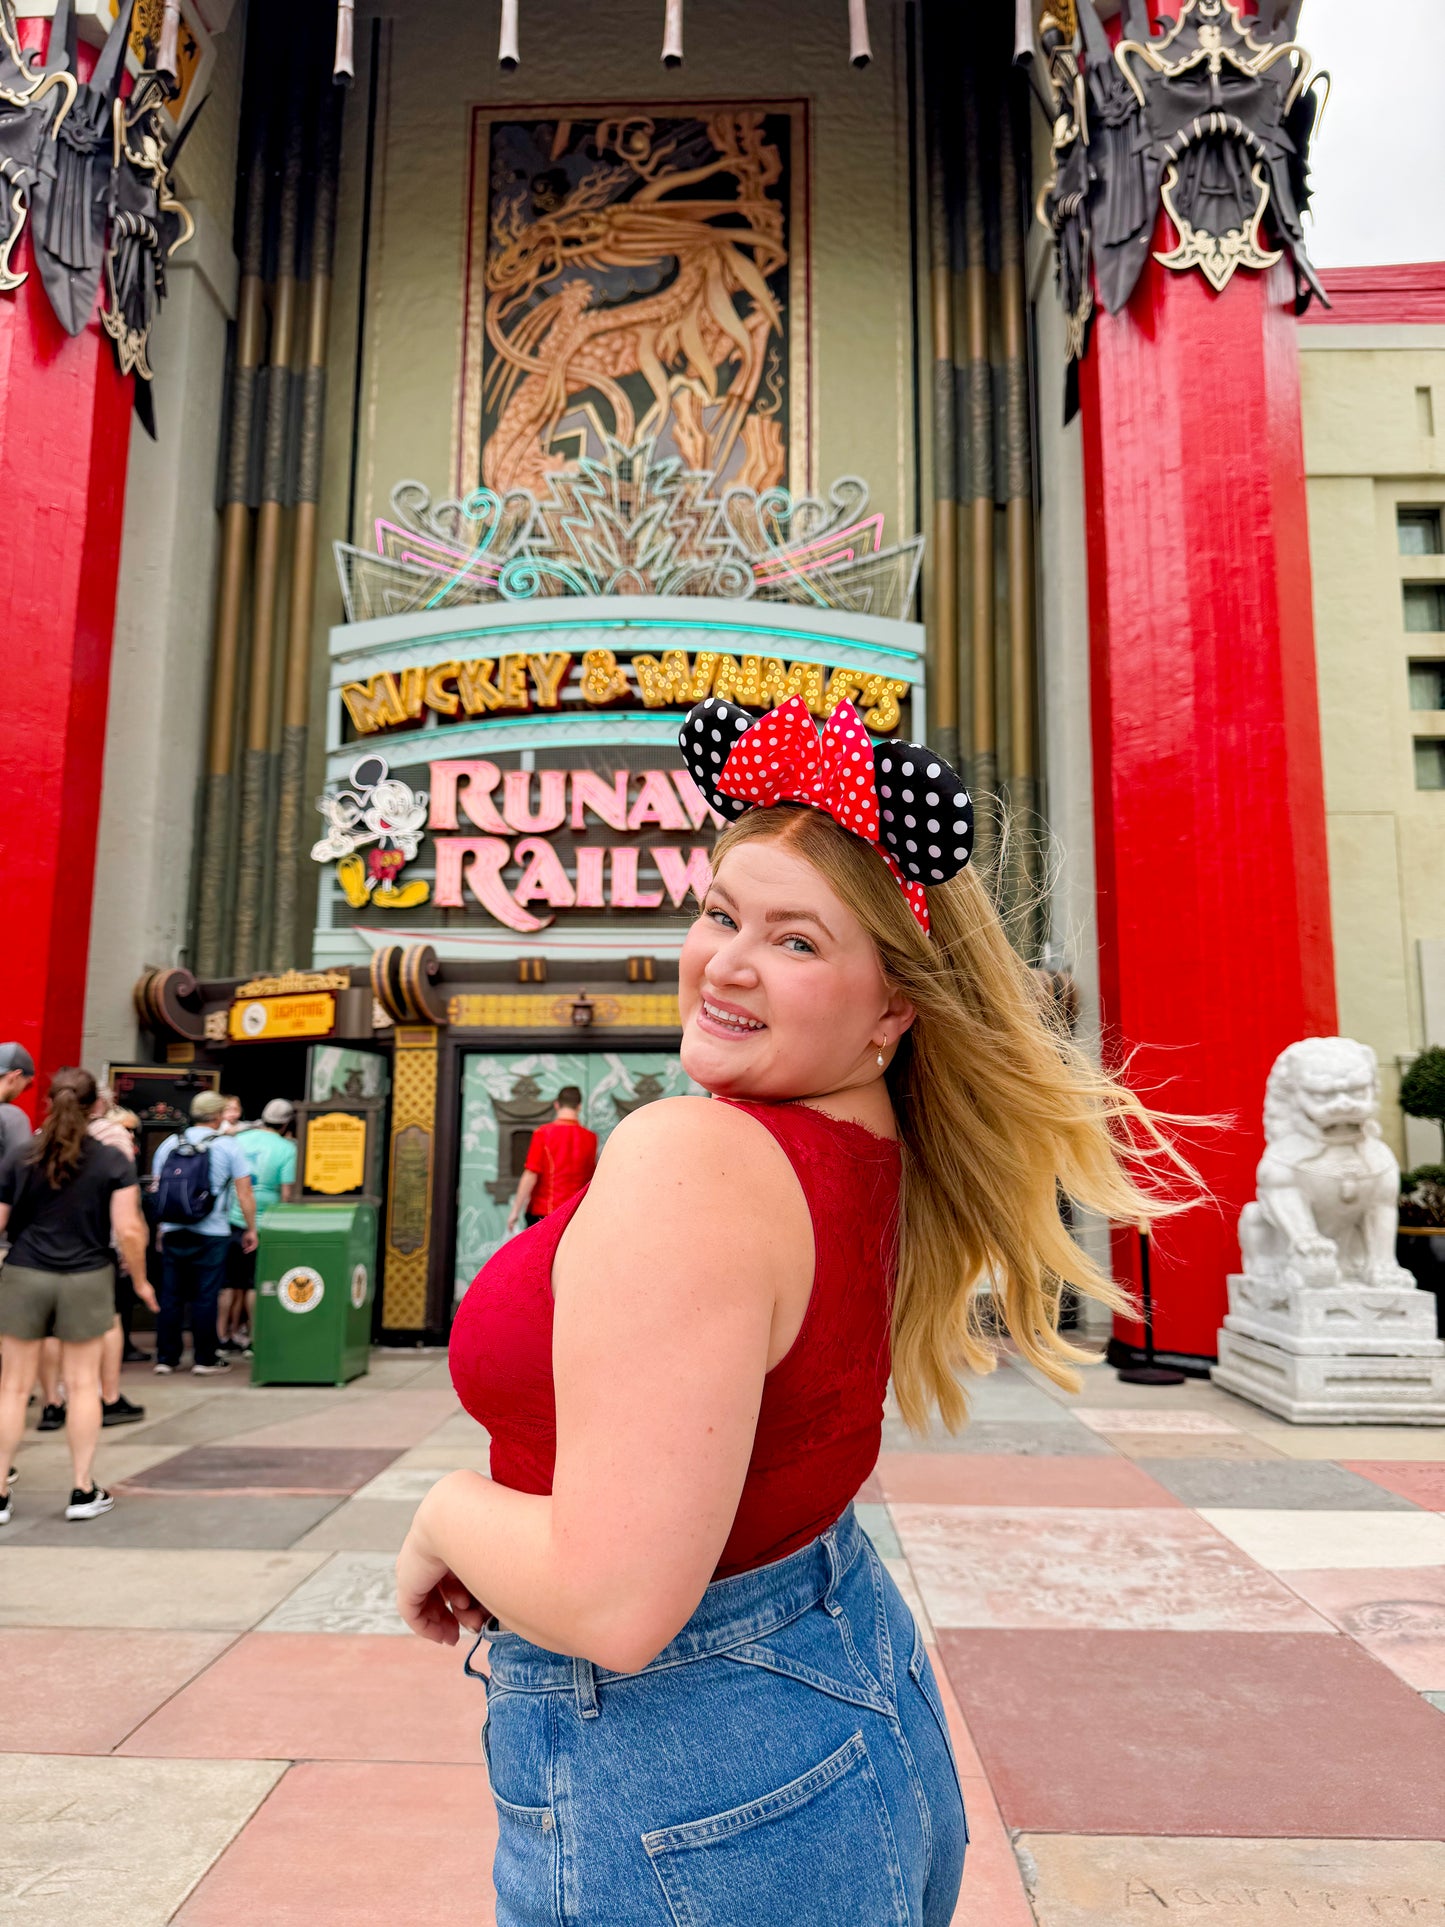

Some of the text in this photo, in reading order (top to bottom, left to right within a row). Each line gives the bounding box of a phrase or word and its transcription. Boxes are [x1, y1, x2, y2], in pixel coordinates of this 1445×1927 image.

[341, 652, 573, 732] MICKEY
[580, 648, 632, 704] &
[429, 760, 735, 835] RUNAW
[434, 837, 714, 932] RAILW
